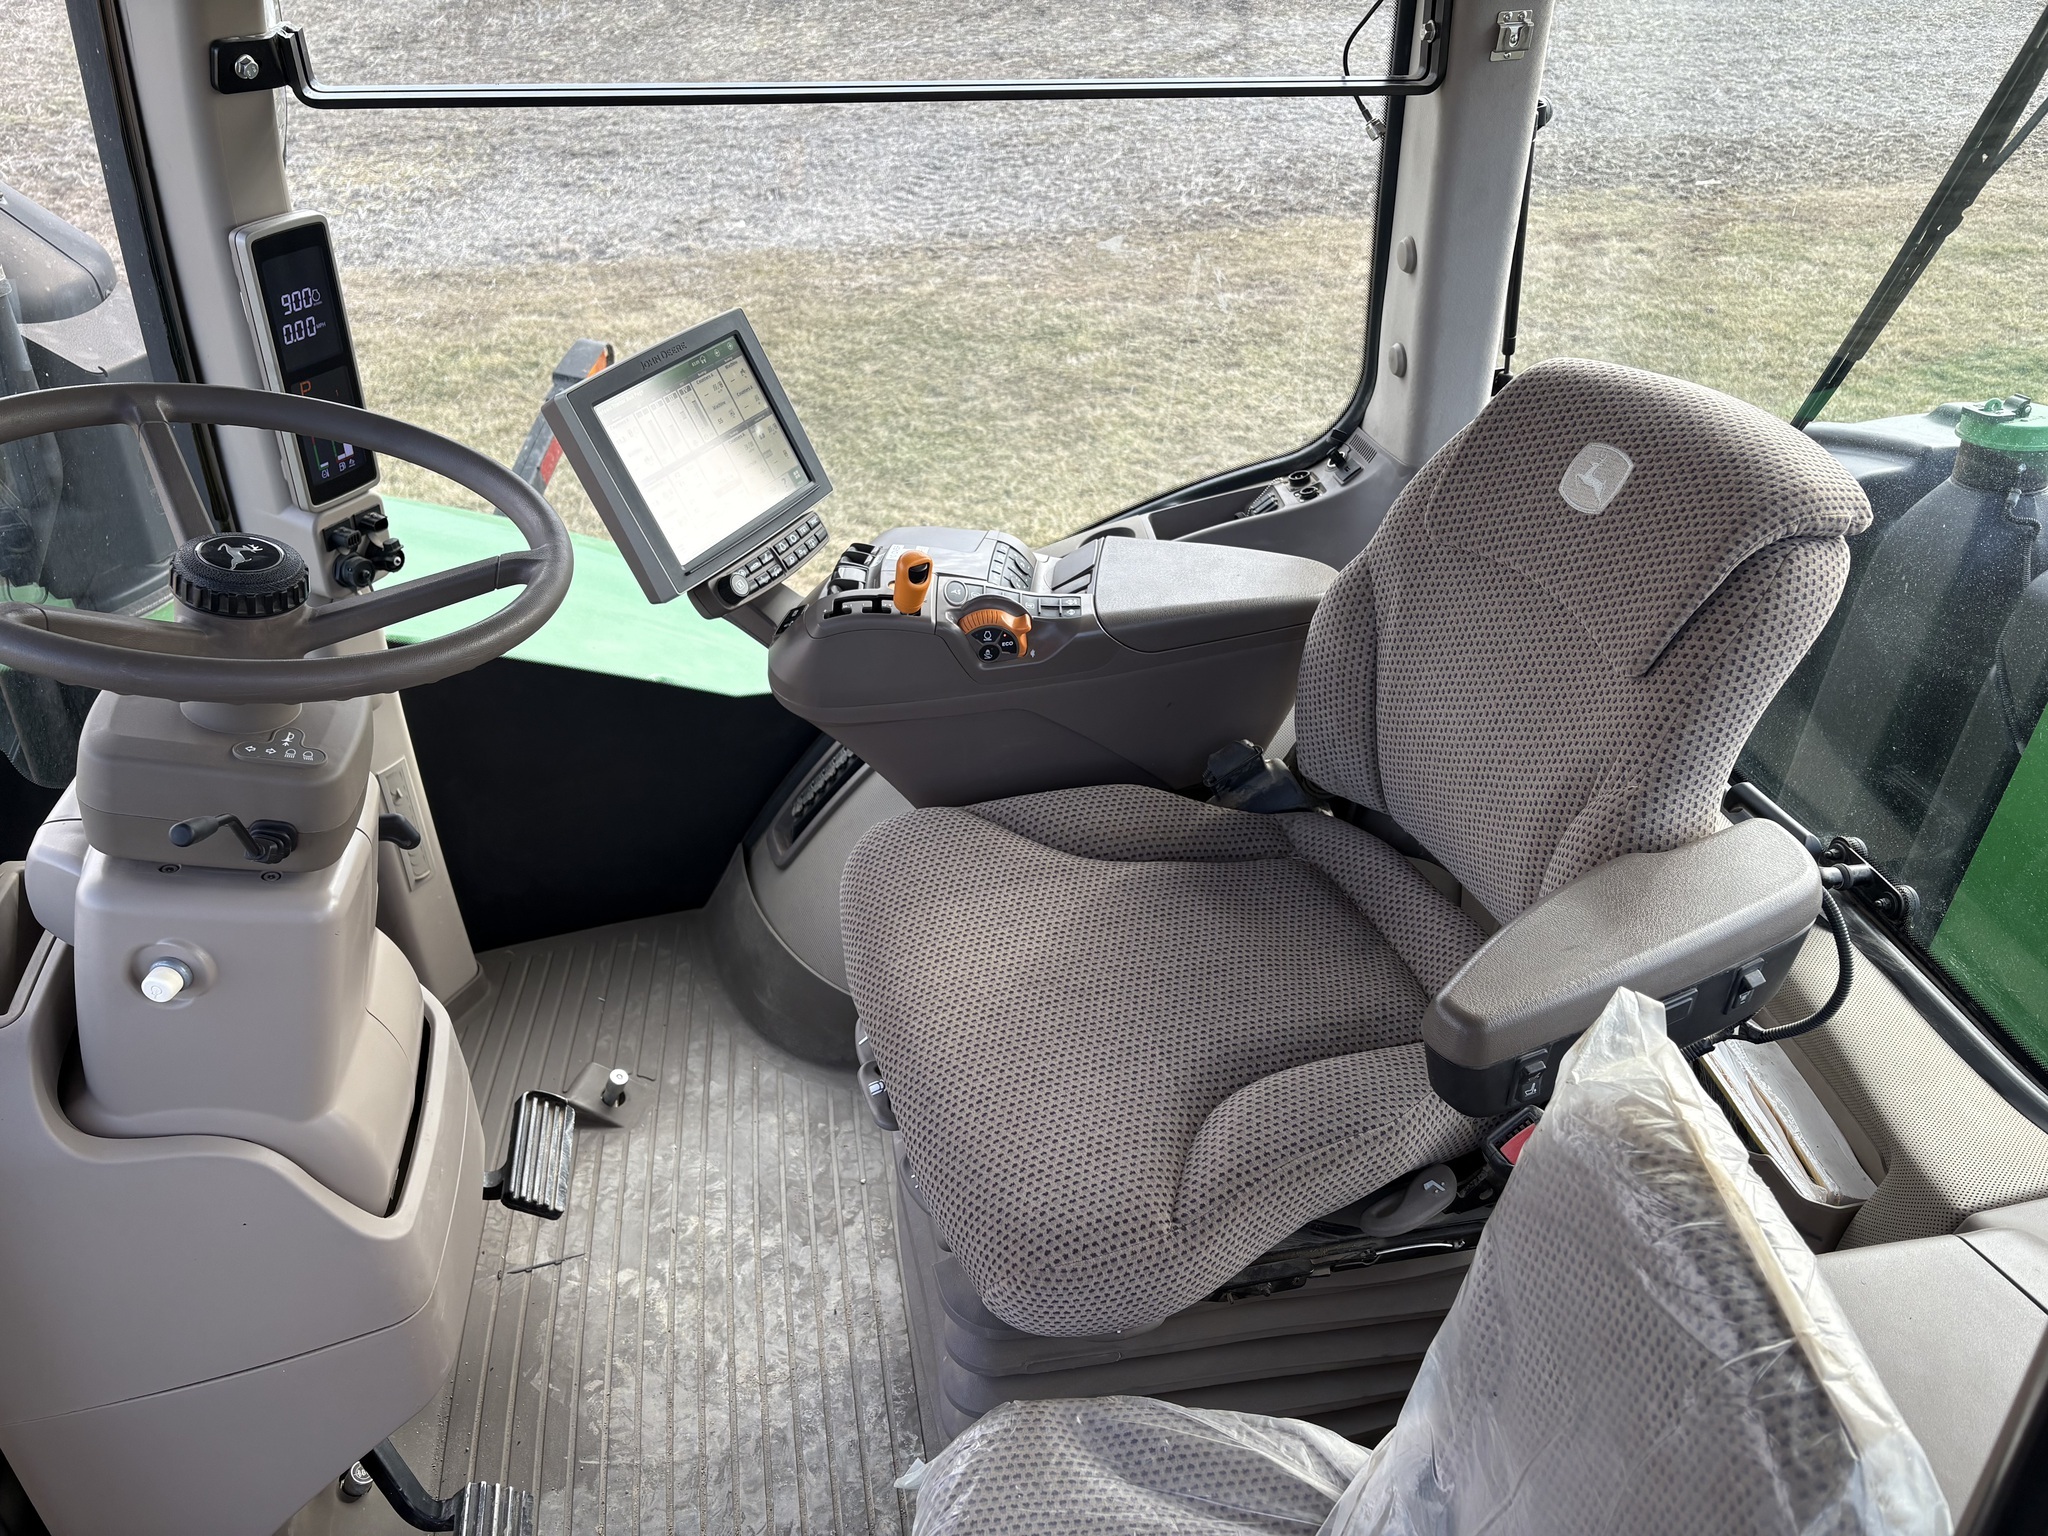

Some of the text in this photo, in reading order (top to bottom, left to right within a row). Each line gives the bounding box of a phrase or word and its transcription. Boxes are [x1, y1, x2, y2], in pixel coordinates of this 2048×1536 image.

[281, 287, 312, 316] 900
[283, 316, 326, 345] 0.00 MPH
[640, 341, 688, 370] JOHN DEERE
[299, 380, 312, 396] P
